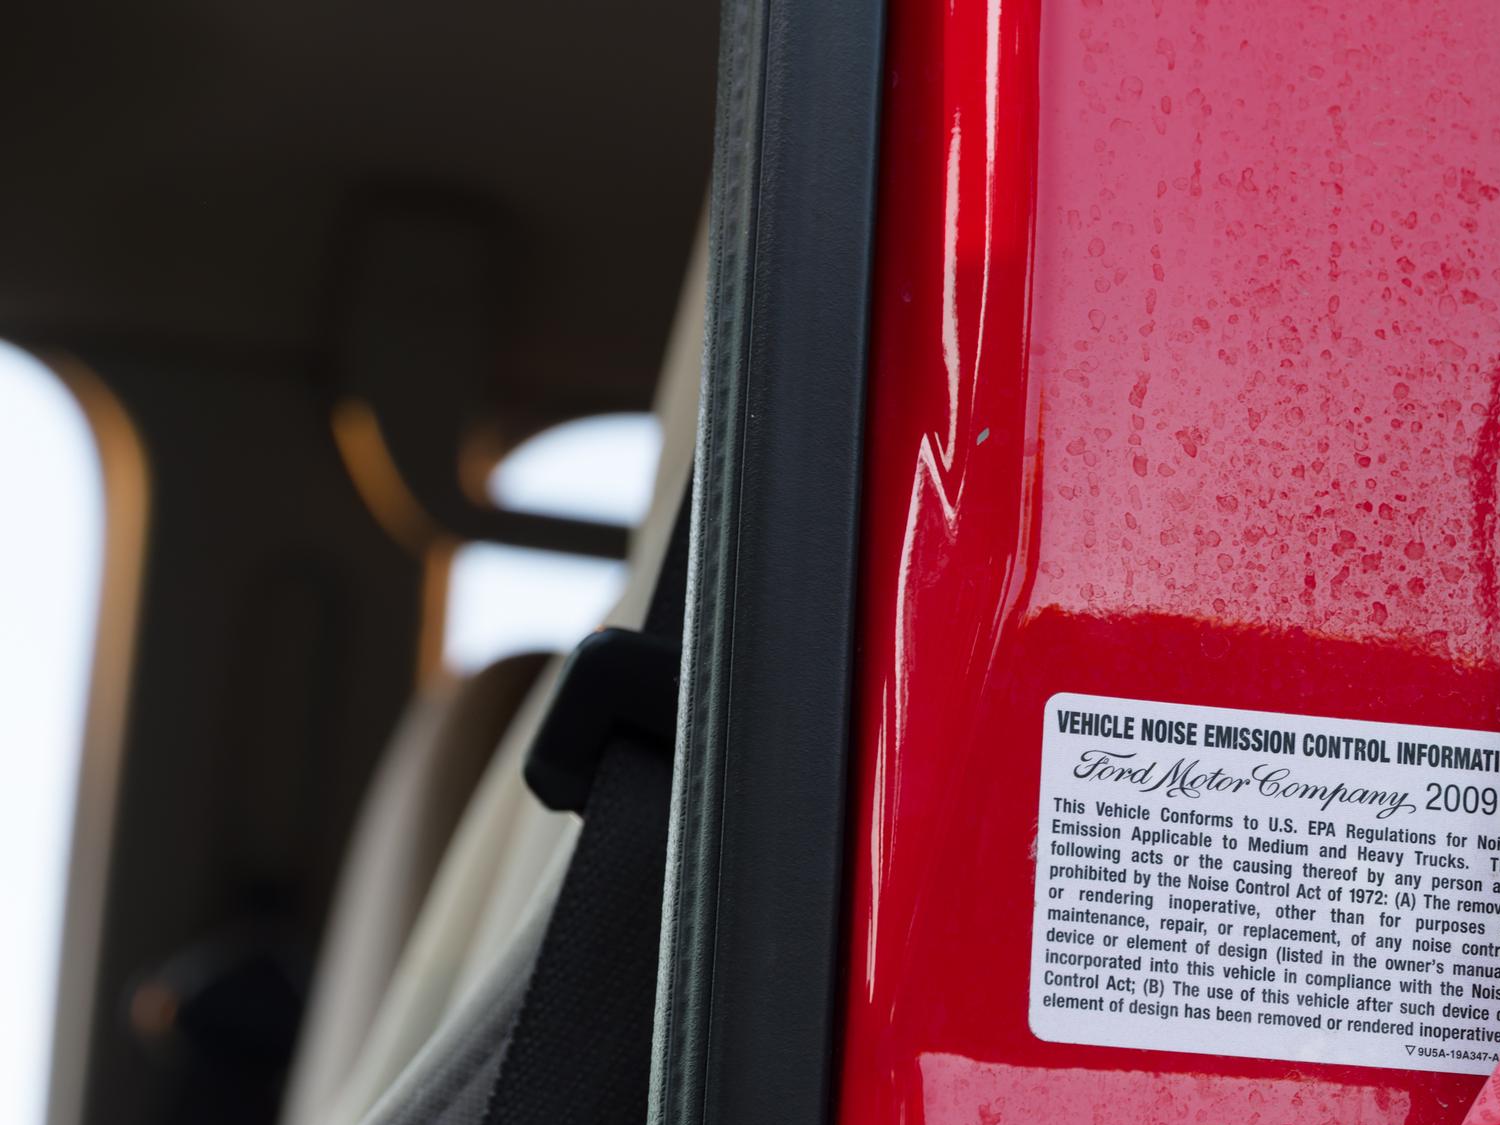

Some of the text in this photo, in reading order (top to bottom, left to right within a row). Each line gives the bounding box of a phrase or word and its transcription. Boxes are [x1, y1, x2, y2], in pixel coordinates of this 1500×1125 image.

[1058, 710, 1134, 739] VEHICLE
[1142, 718, 1197, 745] NOISE
[1204, 724, 1295, 754] EMISSION
[1303, 734, 1390, 762] CONTROL
[1074, 750, 1498, 819] Ford Motor Company 2009
[1052, 819, 1120, 839] Emission
[1132, 827, 1212, 847] Applicable
[1223, 835, 1237, 849] to
[1249, 837, 1308, 856] Medium
[1320, 845, 1346, 859] and
[1358, 846, 1403, 866] Heavy
[1415, 851, 1468, 869] Trucks.
[1054, 798, 1084, 814] This
[1096, 802, 1149, 820] Vehicle
[1161, 808, 1232, 828] Conforms
[1244, 816, 1258, 830] to
[1269, 817, 1296, 833] U.S.
[1309, 821, 1335, 836] EPA
[1347, 824, 1436, 845] Regulations
[1446, 832, 1467, 847] for
[1050, 865, 1126, 882] prohibited
[1134, 870, 1150, 888] by
[1158, 872, 1181, 888] the
[1188, 874, 1228, 892] Noise
[1236, 879, 1289, 897] Control
[1296, 884, 1321, 900] Act
[1328, 887, 1342, 901] of
[1350, 888, 1387, 904] 1972:
[1396, 892, 1415, 910] (A)
[1424, 894, 1450, 910] The
[1051, 841, 1120, 864] following
[1132, 850, 1162, 864] acts
[1174, 855, 1189, 866] or
[1199, 854, 1222, 870] the
[1234, 860, 1292, 879] causing
[1303, 864, 1357, 881] thereof
[1368, 868, 1384, 886] by
[1395, 874, 1421, 889] any
[1432, 877, 1482, 892] person
[1048, 908, 1148, 930] maintenance,
[1161, 918, 1206, 935] repair,
[1218, 924, 1233, 935] or
[1244, 924, 1340, 946] replacement,
[1352, 932, 1366, 946] of
[1376, 937, 1402, 952] any
[1413, 938, 1451, 953] noise
[1049, 888, 1064, 898] or
[1080, 889, 1152, 910] rendering
[1170, 895, 1259, 918] inoperative,
[1276, 905, 1316, 920] other
[1330, 909, 1364, 924] than
[1380, 912, 1401, 927] for
[1416, 918, 1485, 934] purposes
[1047, 928, 1094, 945] device
[1104, 935, 1118, 946] or
[1127, 935, 1187, 952] element
[1196, 940, 1210, 954] of
[1218, 942, 1267, 962] design
[1277, 947, 1322, 964] (listed
[1332, 952, 1344, 966] in
[1354, 954, 1376, 968] the
[1045, 971, 1098, 988] Control
[1106, 976, 1135, 994] Act;
[1144, 979, 1164, 997] (B)
[1173, 981, 1199, 997] The
[1208, 987, 1232, 1000] use
[1241, 988, 1255, 1001] of
[1262, 989, 1288, 1004] this
[1297, 993, 1349, 1009] vehicle
[1357, 997, 1392, 1012] after
[1400, 1002, 1434, 1016] such
[1442, 1003, 1489, 1020] device
[1046, 949, 1141, 970] incorporated
[1150, 958, 1178, 973] into
[1187, 961, 1214, 976] this
[1224, 965, 1275, 982] vehicle
[1285, 969, 1296, 983] in
[1306, 974, 1391, 991] compliance
[1400, 979, 1431, 994] with
[1440, 982, 1463, 997] the
[1044, 993, 1104, 1011] element
[1110, 998, 1124, 1012] of
[1130, 1000, 1178, 1019] design
[1185, 1004, 1210, 1019] has
[1217, 1006, 1251, 1022] been
[1258, 1013, 1321, 1028] removed
[1328, 1018, 1342, 1030] or
[1348, 1019, 1413, 1036] rendered
